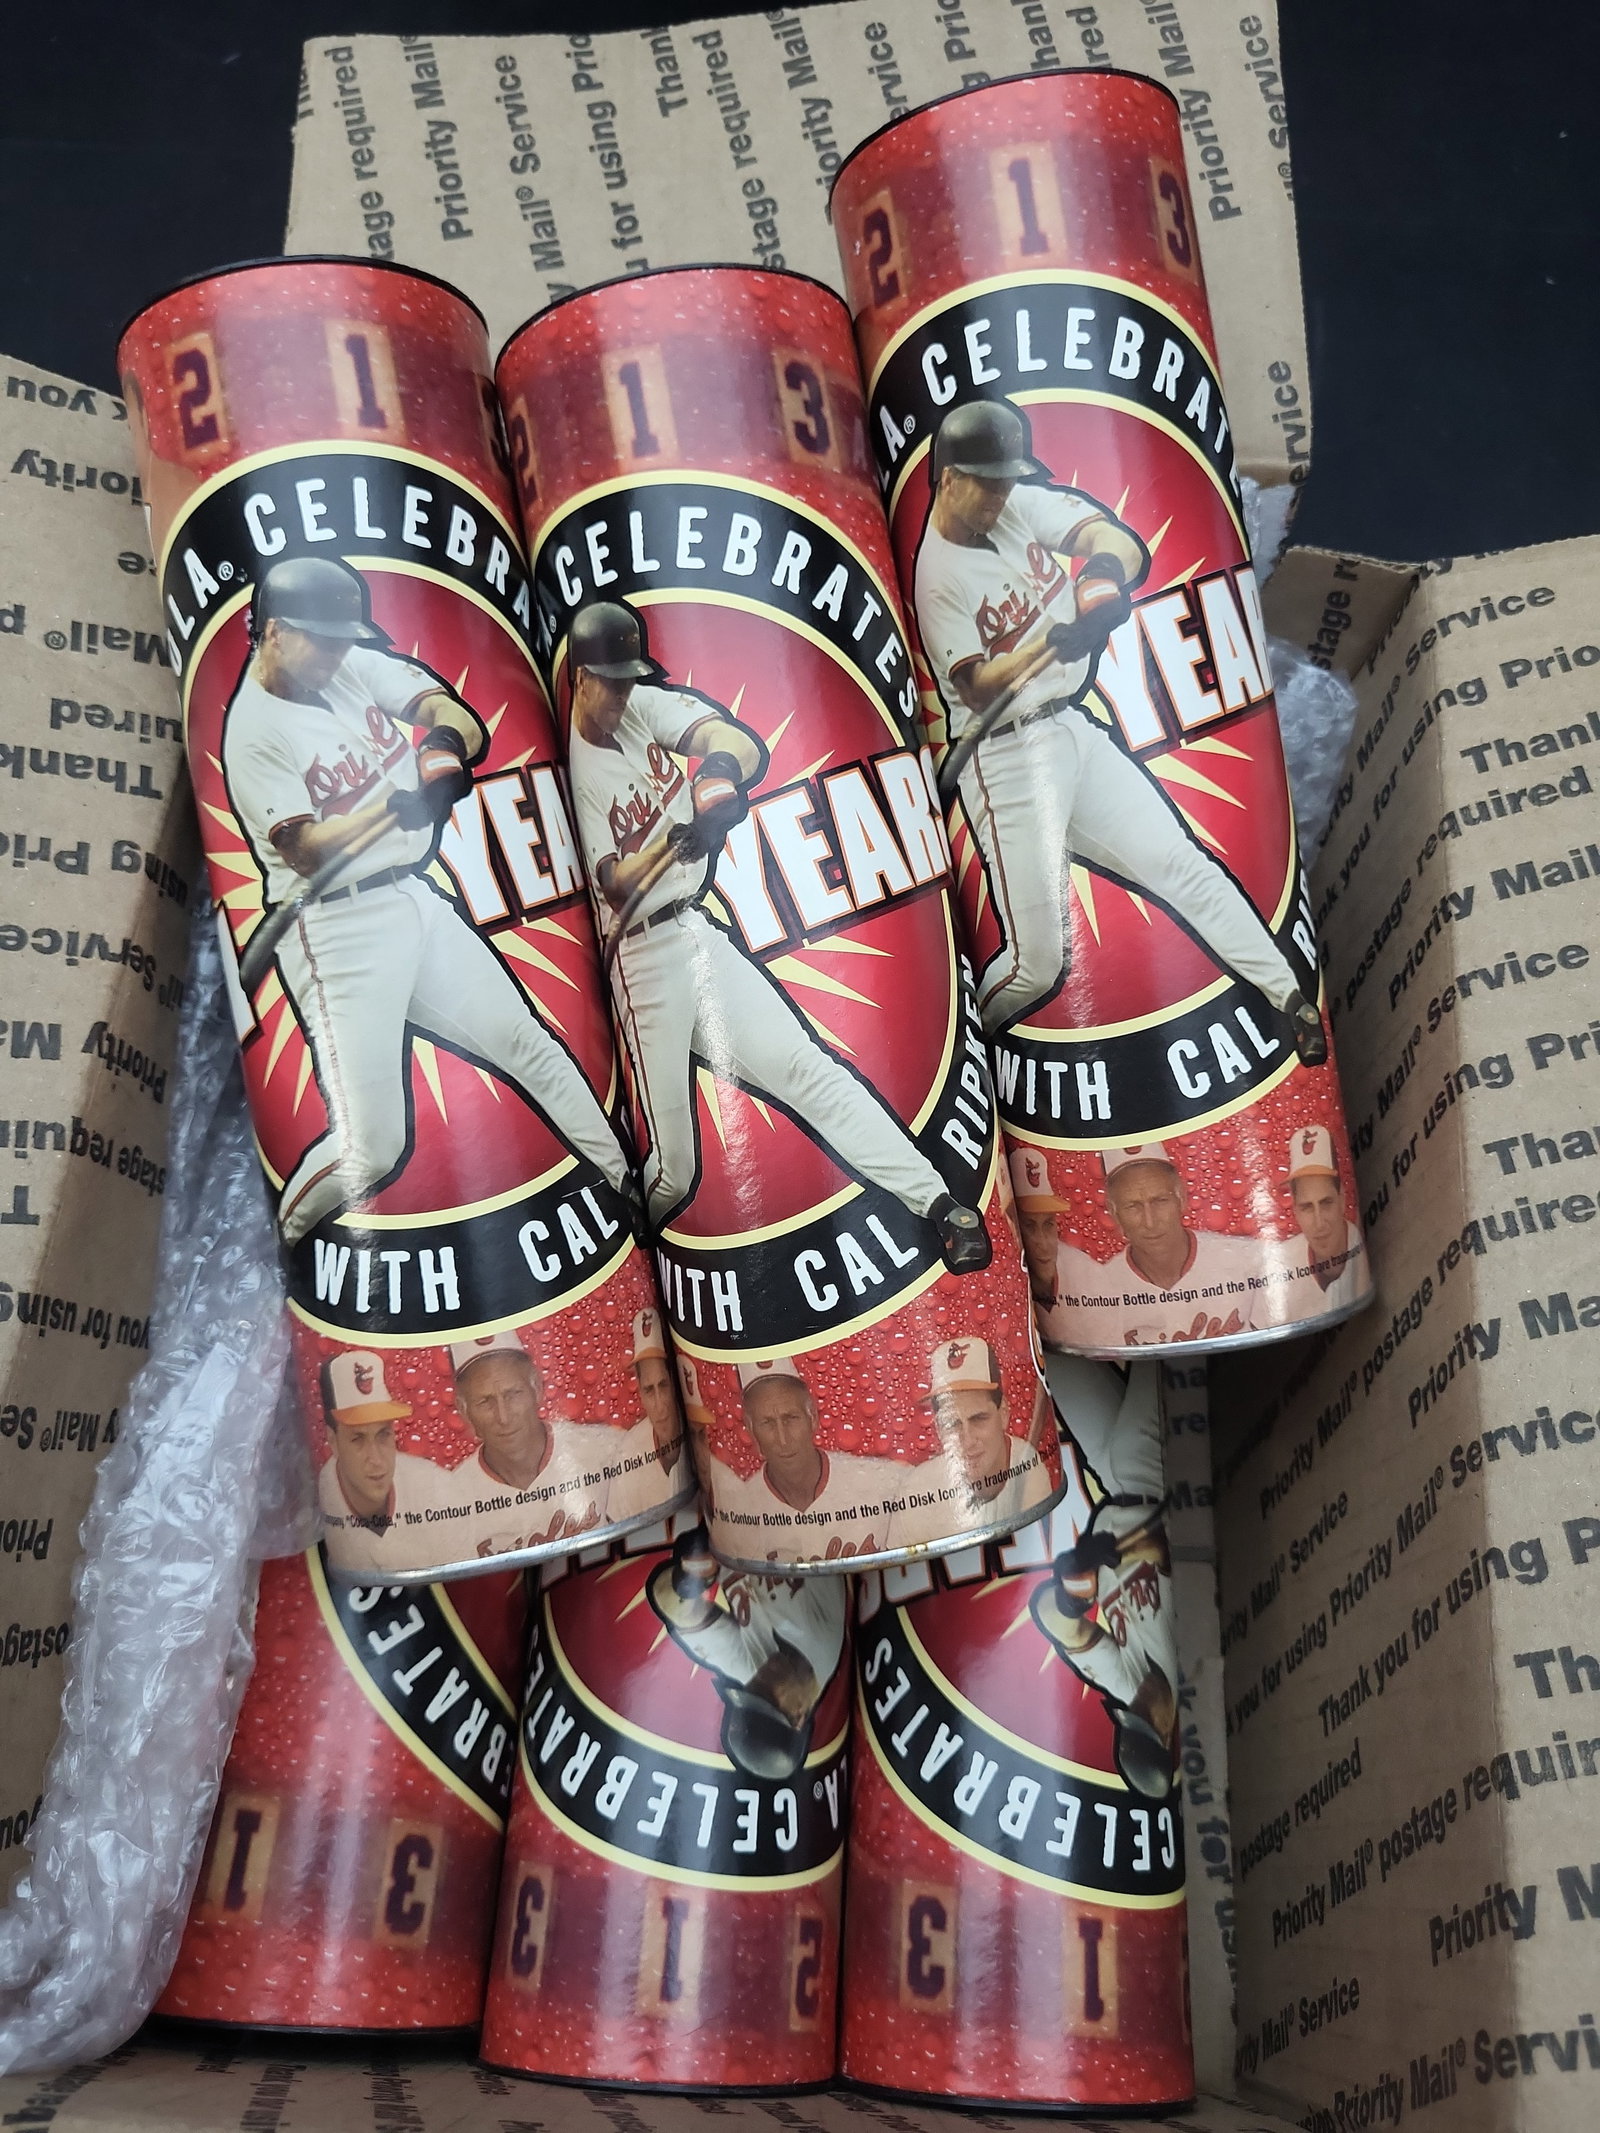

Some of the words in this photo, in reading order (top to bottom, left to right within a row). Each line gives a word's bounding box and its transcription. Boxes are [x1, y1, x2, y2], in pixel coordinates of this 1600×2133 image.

[1140, 0, 1195, 78] Mail
[1239, 14, 1289, 150] Service
[324, 45, 378, 181] required
[495, 55, 541, 175] Service
[587, 100, 628, 191] using
[691, 29, 758, 170] required
[425, 120, 474, 241] Priority
[1179, 88, 1243, 222] Priority
[610, 201, 644, 252] for
[862, 207, 900, 306] 2
[1008, 158, 1049, 256] 1
[1159, 171, 1192, 267] 3
[6, 376, 98, 416] you
[172, 347, 220, 448] 2
[345, 333, 388, 430] 1
[618, 360, 661, 458] 1
[784, 360, 832, 455] 3
[10, 448, 144, 507] iority
[555, 506, 918, 718] CELEBRATES
[1405, 587, 1555, 676] Service
[1402, 677, 1488, 766] using
[1415, 765, 1593, 877] required
[0, 924, 157, 992] Service
[1388, 885, 1475, 1012] Priority
[1427, 944, 1590, 1034] Service
[81, 1020, 168, 1104] Priority
[995, 1046, 1112, 1121] WITH
[1167, 1006, 1280, 1099] CAL
[1391, 1131, 1418, 1188] for
[1423, 1053, 1515, 1140] using
[314, 1238, 461, 1314] WITH
[518, 1186, 619, 1283] CAL
[794, 1214, 919, 1312] CAL
[1066, 1293, 1079, 1307] the
[1081, 1294, 1120, 1308] Contour
[1123, 1292, 1156, 1307] Bottle
[1159, 1287, 1199, 1304] design
[1201, 1282, 1224, 1298] and
[1226, 1277, 1245, 1294] the
[1362, 1276, 1434, 1397] postage
[1436, 1190, 1600, 1285] require
[80, 1306, 115, 1349] for
[1408, 1317, 1502, 1429] Priority
[405, 1511, 423, 1525] the
[425, 1504, 472, 1523] Contour
[475, 1494, 512, 1514] Bottle
[515, 1484, 557, 1507] design
[559, 1478, 581, 1494] and
[582, 1471, 601, 1486] the
[603, 1462, 622, 1480] Red
[624, 1454, 644, 1473] Disk
[731, 1511, 760, 1526] Contour
[763, 1511, 792, 1526] Bottle
[795, 1510, 832, 1526] design
[835, 1506, 858, 1521] and
[860, 1503, 879, 1518] the
[882, 1497, 906, 1514] Red
[910, 1491, 936, 1509] Disk
[984, 1459, 1031, 1488] trademarks
[1285, 1611, 1327, 1674] using
[1329, 1538, 1392, 1627] Priority
[1449, 1406, 1600, 1488] Servic
[1318, 1664, 1373, 1738] Thank
[1373, 1632, 1408, 1697] you
[1412, 1596, 1441, 1650] for
[1445, 1537, 1549, 1616] using
[865, 1636, 1175, 1872] CELEBRATES
[1294, 1737, 1362, 1830] required
[223, 1809, 262, 1912] 1
[385, 1833, 434, 1935] 3
[1272, 1884, 1325, 1948] Priority
[1378, 1788, 1458, 1882] postage
[511, 1876, 545, 1978] 3
[660, 1896, 689, 2003] 1
[907, 1895, 948, 1999] 3
[1078, 1917, 1105, 2022] 1
[1429, 1882, 1538, 1966] Priority
[1300, 1977, 1360, 2037] Service
